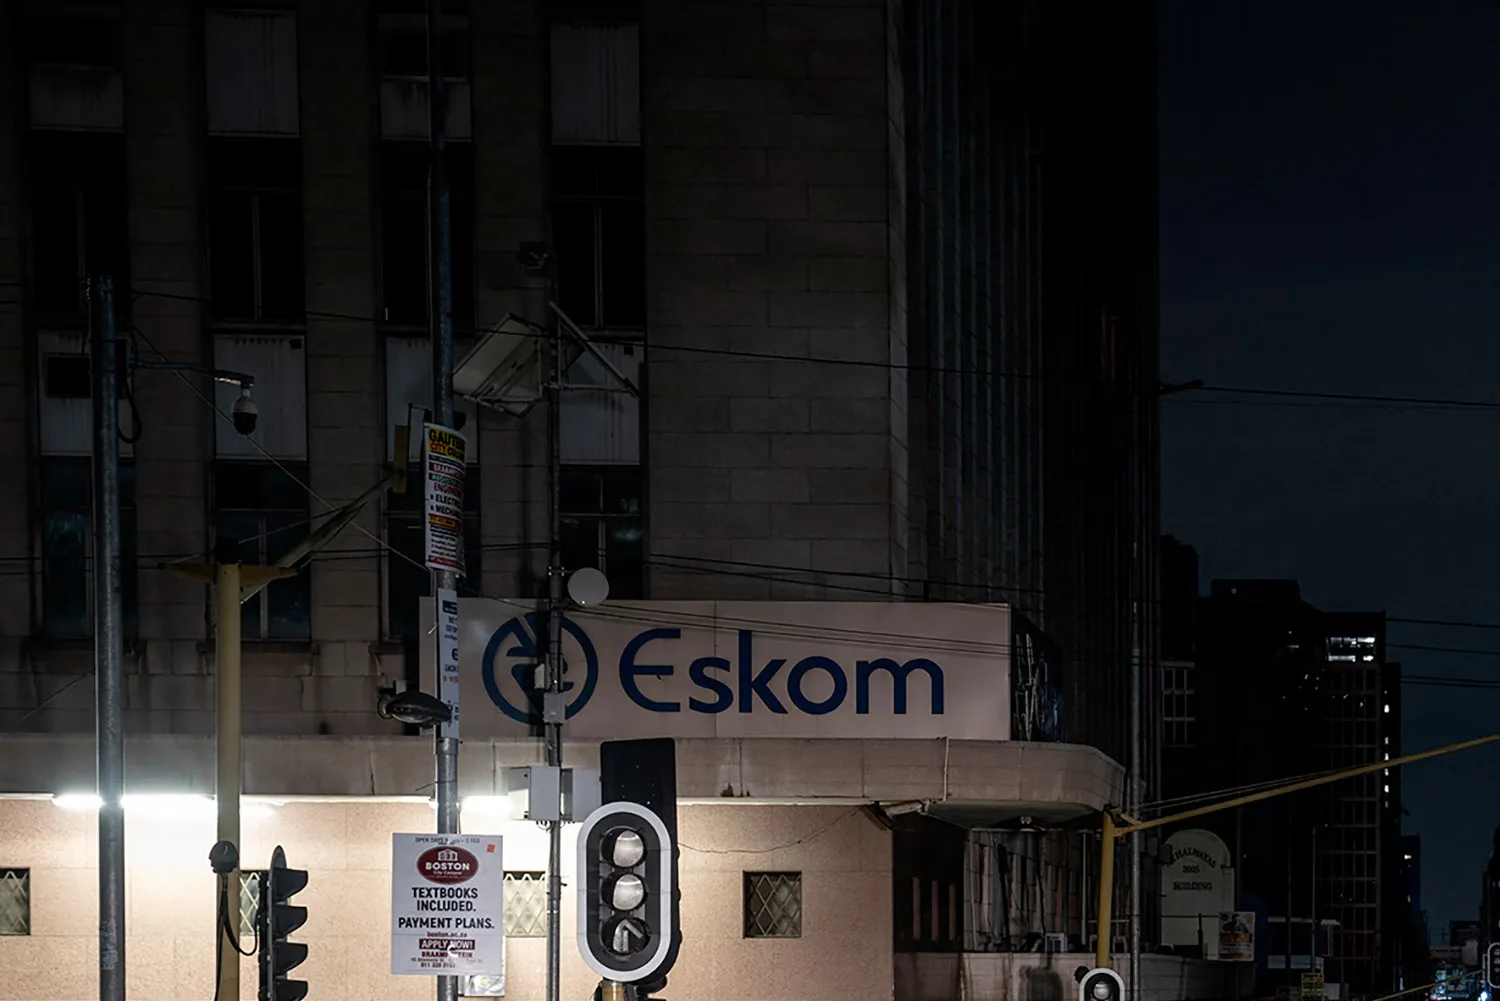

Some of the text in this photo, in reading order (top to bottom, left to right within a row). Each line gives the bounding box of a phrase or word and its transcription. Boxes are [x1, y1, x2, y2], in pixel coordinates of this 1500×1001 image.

[619, 628, 945, 716] Eskom
[425, 862, 470, 871] BOSTON
[1172, 881, 1213, 891] BUILDING
[411, 887, 479, 899] TEXTBOOKS
[416, 899, 477, 912] INCLUDED.
[398, 917, 495, 929] PAYMENT PLANS.
[420, 939, 449, 950] APPLY
